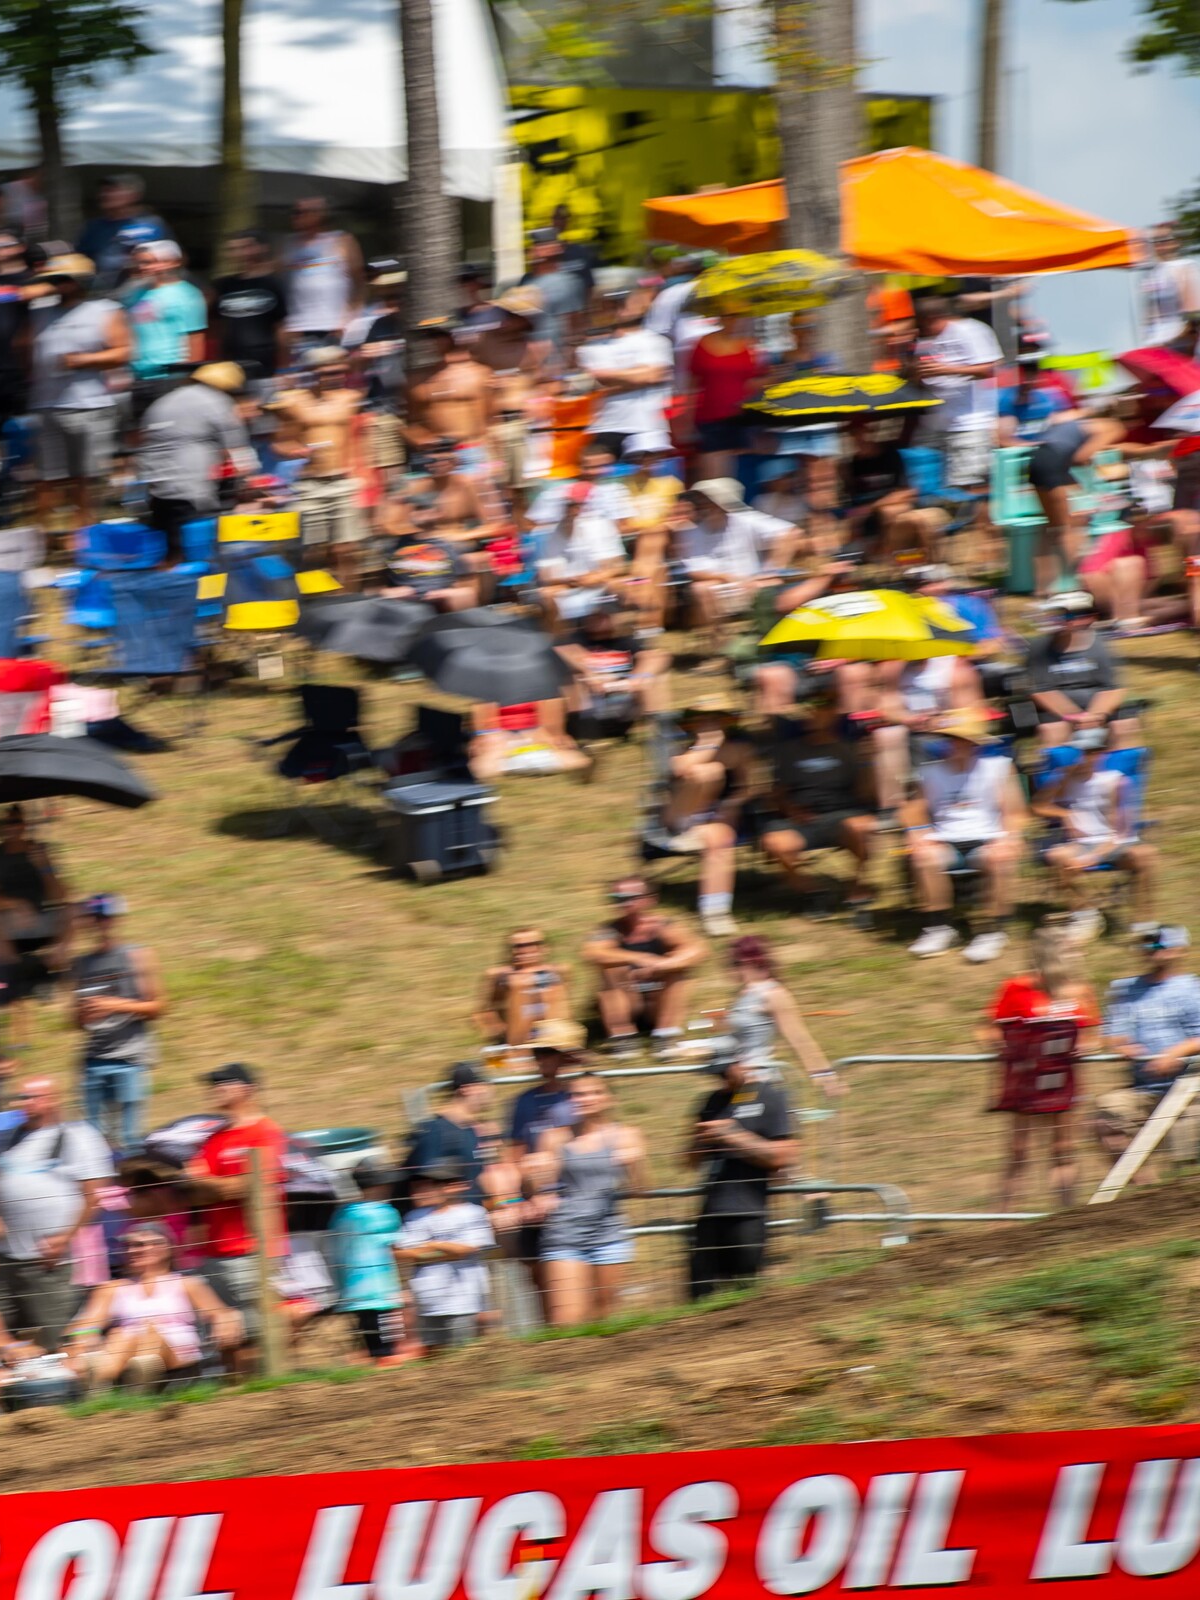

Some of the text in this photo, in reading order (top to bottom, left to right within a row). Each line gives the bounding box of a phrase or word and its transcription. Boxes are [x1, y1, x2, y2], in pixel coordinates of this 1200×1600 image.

[14, 1512, 236, 1600] OIL
[291, 1469, 978, 1600] LUCAS OIL
